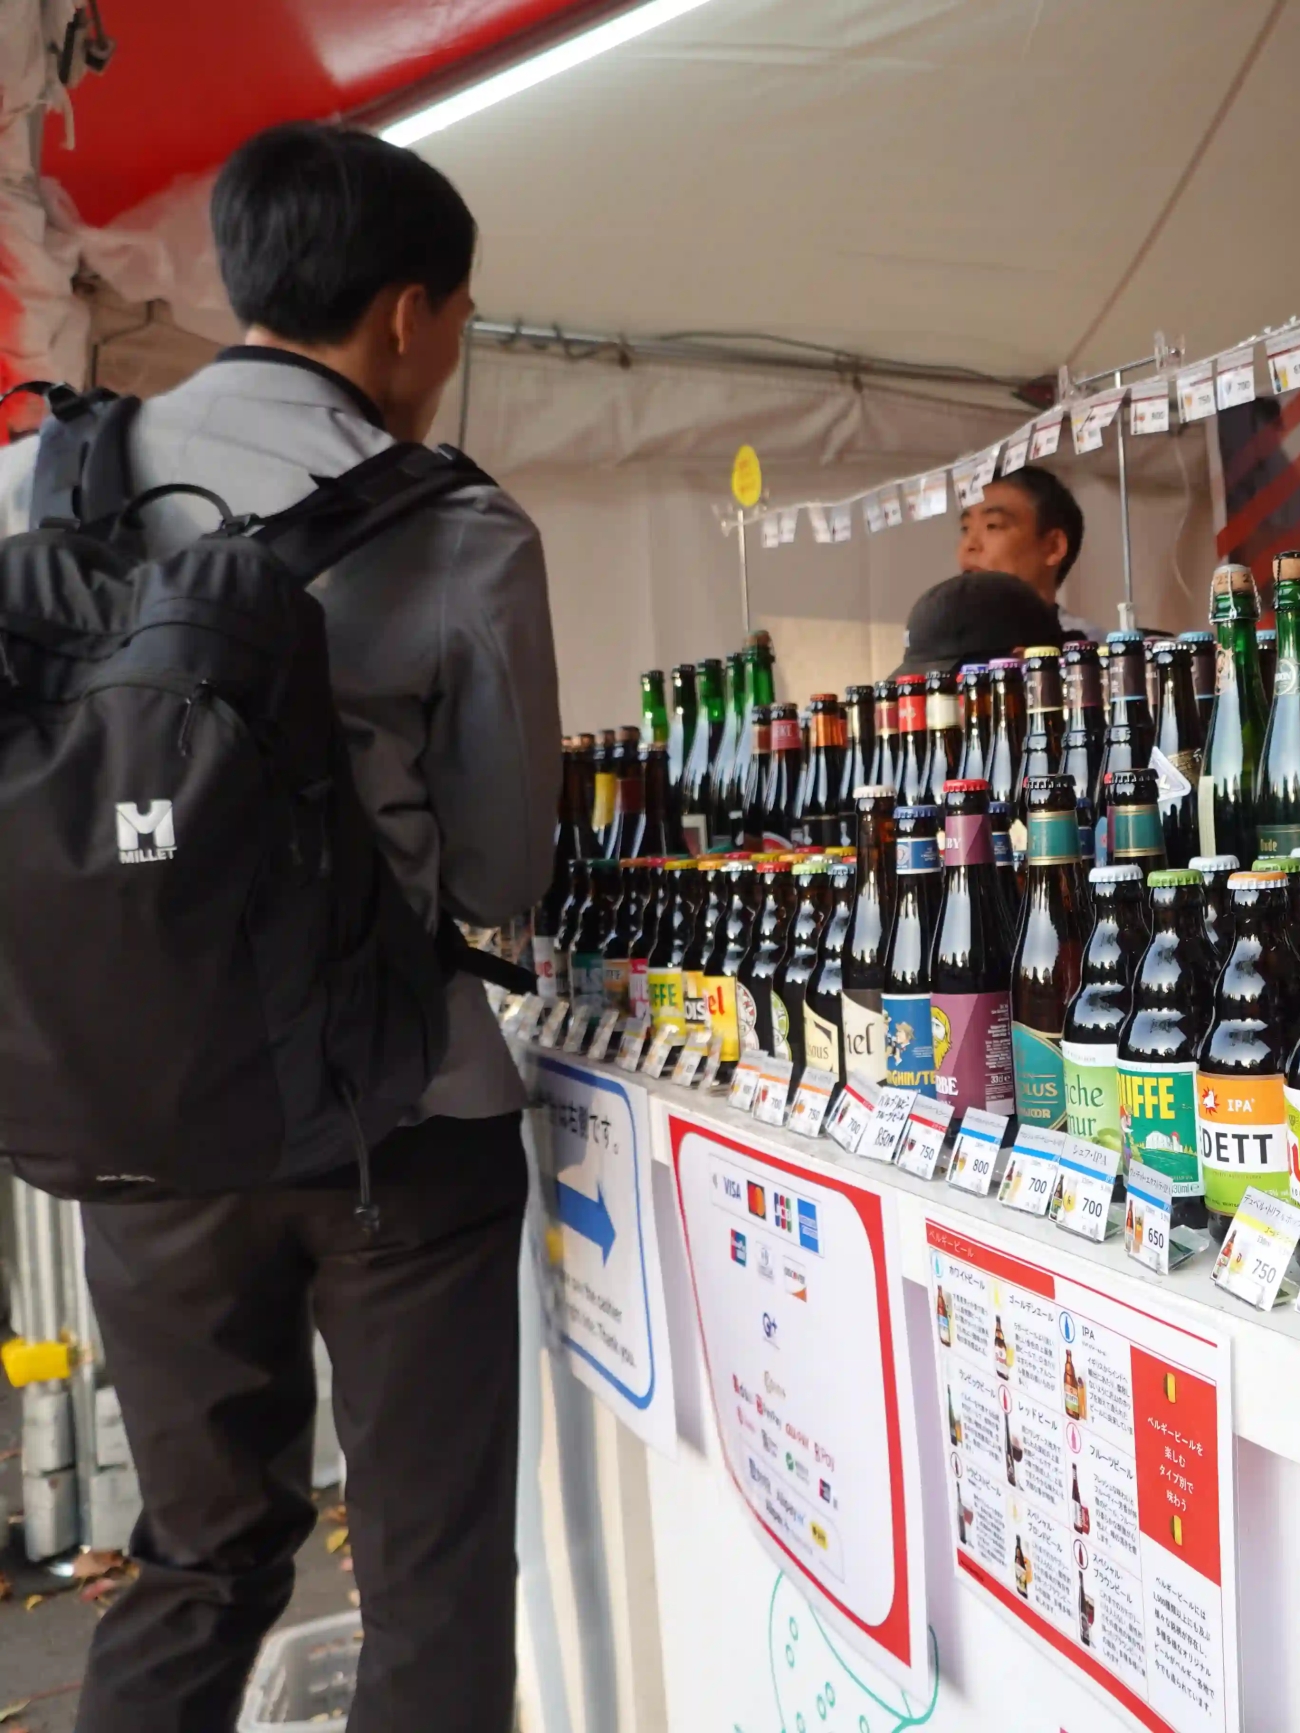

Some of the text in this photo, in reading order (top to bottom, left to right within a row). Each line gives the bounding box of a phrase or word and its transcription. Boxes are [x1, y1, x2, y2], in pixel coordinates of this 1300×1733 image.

[120, 846, 177, 864] MILLET
[1227, 1098, 1253, 1113] IPA
[846, 1117, 861, 1135] 700
[919, 1144, 935, 1160] 750
[972, 1159, 990, 1175] 800
[723, 1175, 742, 1201] VISA
[1028, 1177, 1048, 1194] 700
[1082, 1197, 1103, 1218] 700
[929, 1230, 975, 1258] ベルギービール
[1148, 1227, 1165, 1249] 650
[948, 1265, 986, 1291] ホワイトビール
[1251, 1257, 1277, 1284] 750
[1008, 1294, 1054, 1323] ゴールデンエール
[1081, 1325, 1096, 1341] IPA
[1018, 1400, 1058, 1431] レッドビール
[1147, 1416, 1204, 1457] ベルギービールを
[1089, 1444, 1134, 1480] フルーツビール
[1164, 1445, 1186, 1468] 楽しむ
[1159, 1464, 1195, 1494] タイプ別で
[1165, 1489, 1187, 1512] 味わう
[1093, 1567, 1133, 1605] ブラウンビール
[1155, 1575, 1207, 1621] ベルギービールには
